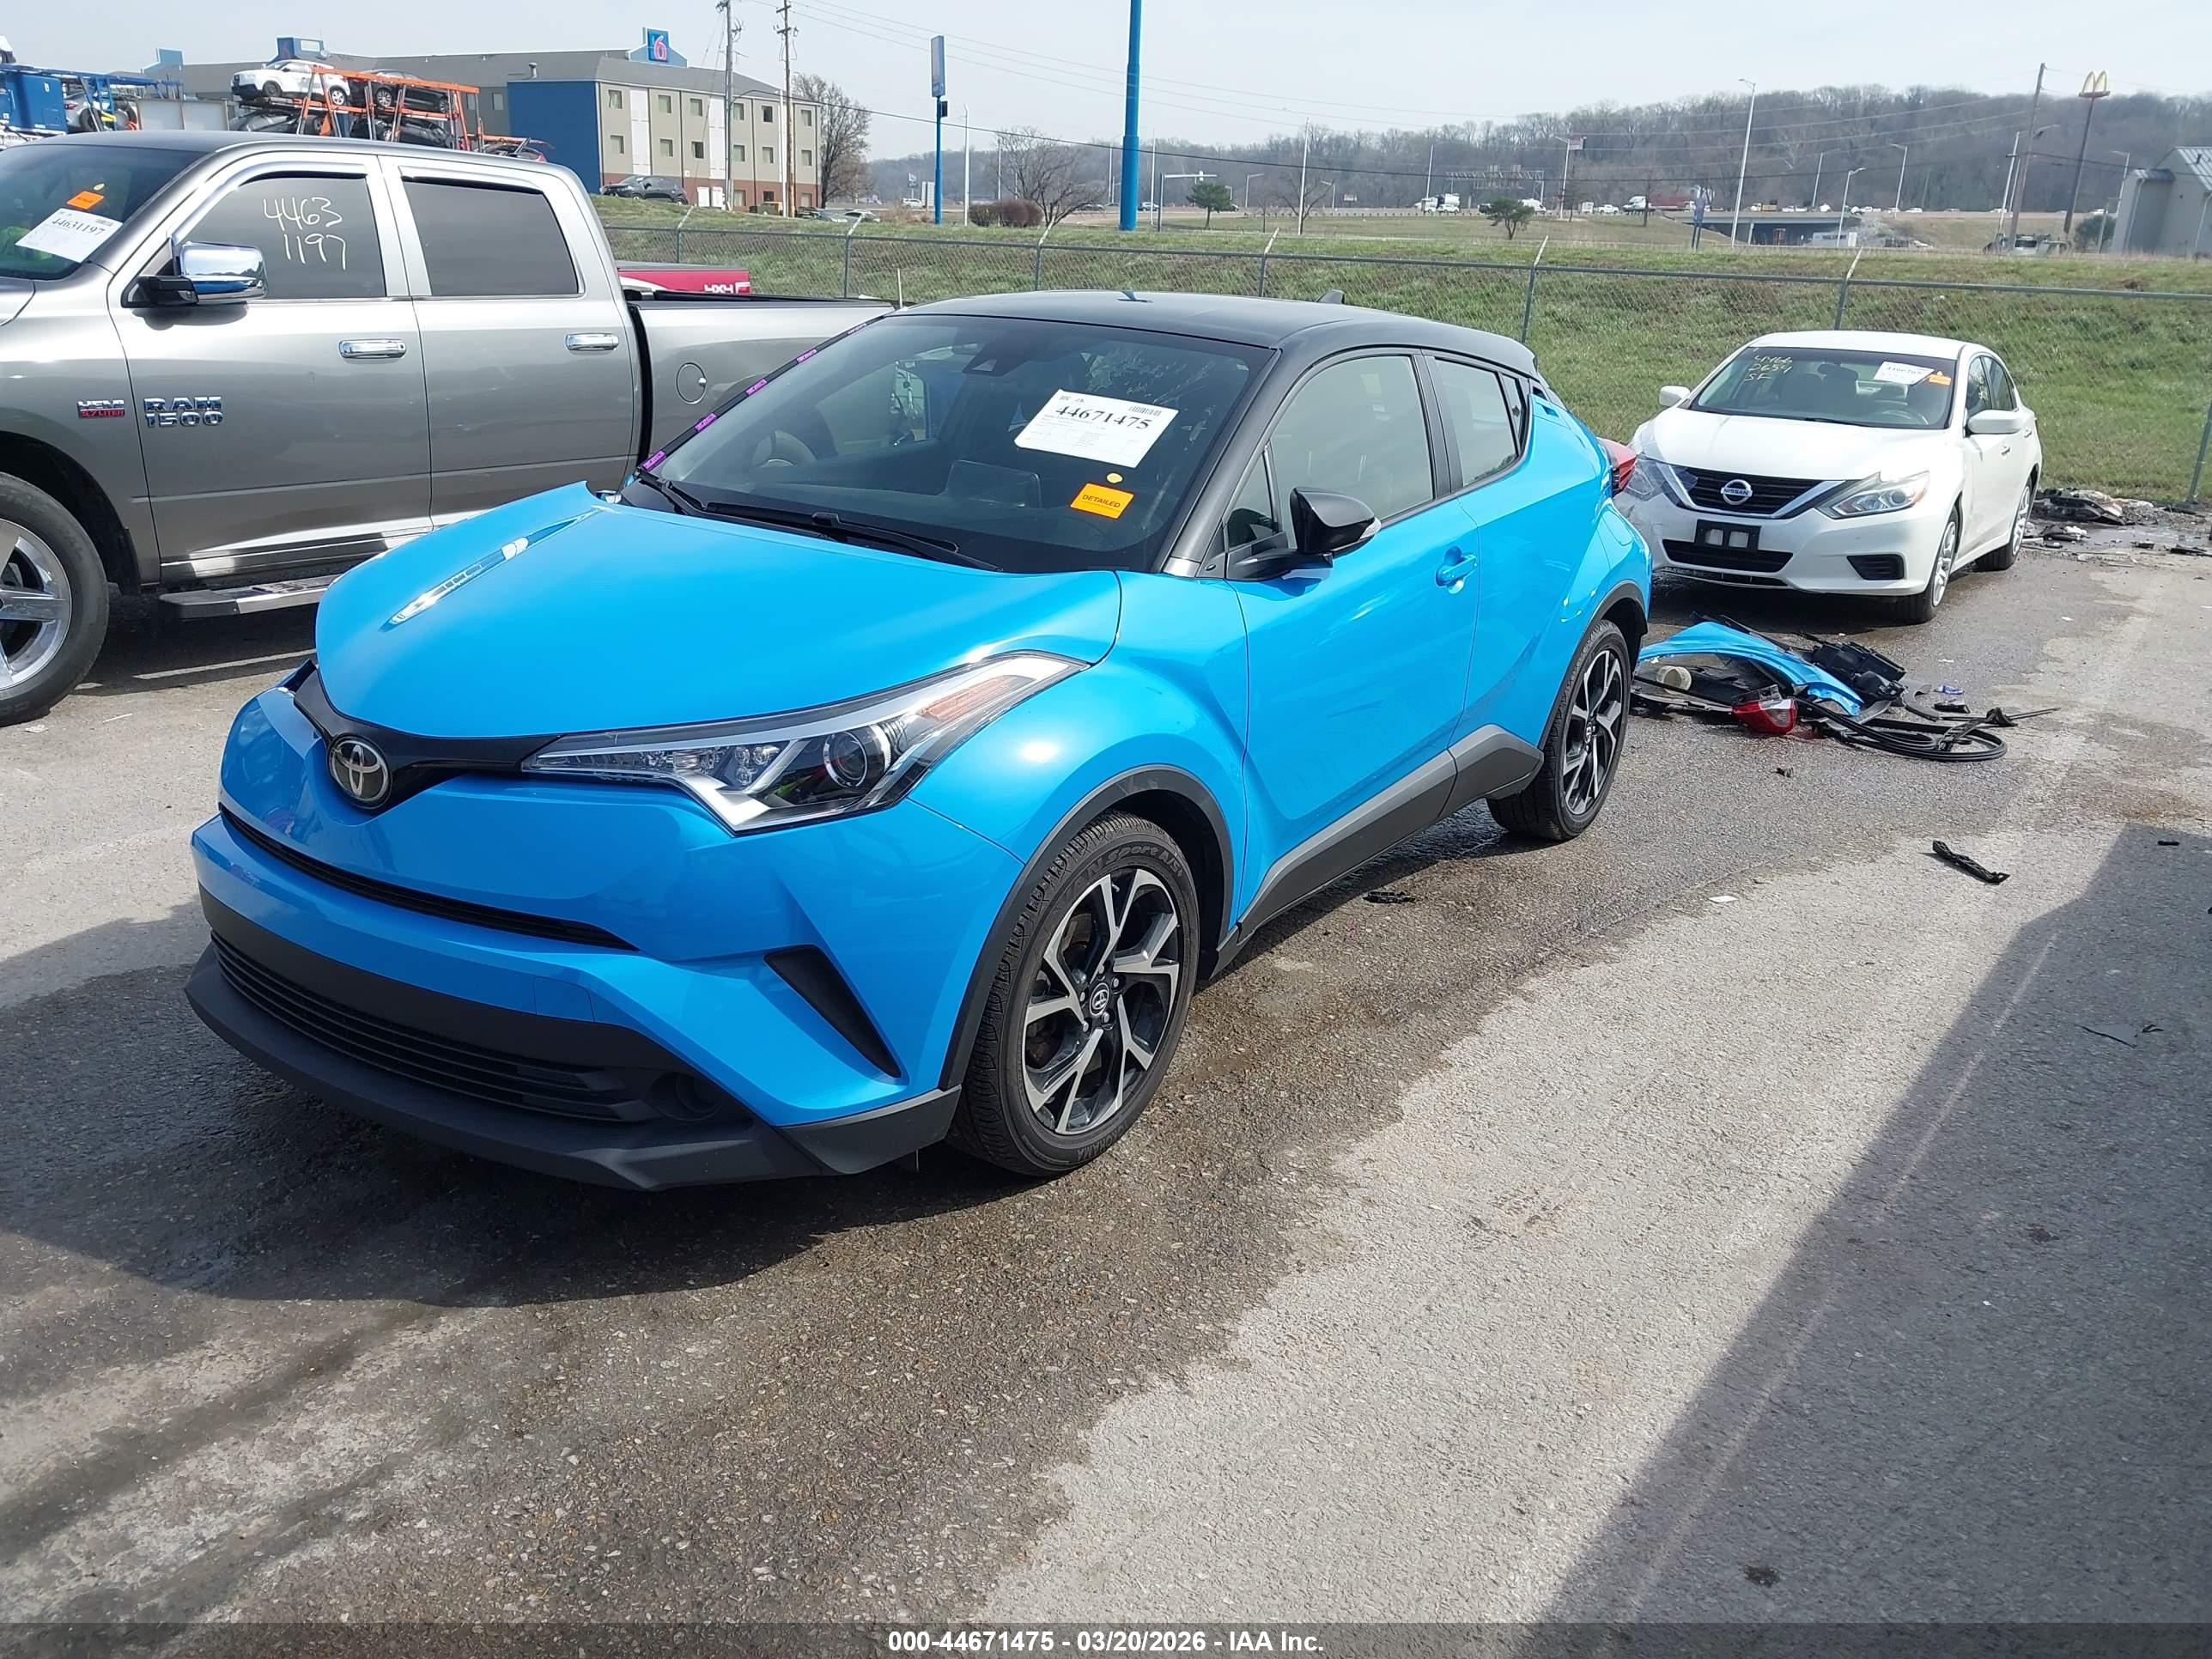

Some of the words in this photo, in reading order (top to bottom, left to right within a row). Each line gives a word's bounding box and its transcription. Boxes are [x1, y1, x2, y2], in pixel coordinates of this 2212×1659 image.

[653, 35, 667, 60] 6
[263, 196, 343, 231] 4463
[283, 233, 346, 270] 1197
[143, 396, 222, 411] RAM
[146, 411, 223, 428] 1500
[1055, 405, 1153, 429] 44671475
[1082, 494, 1121, 508] DETAILED
